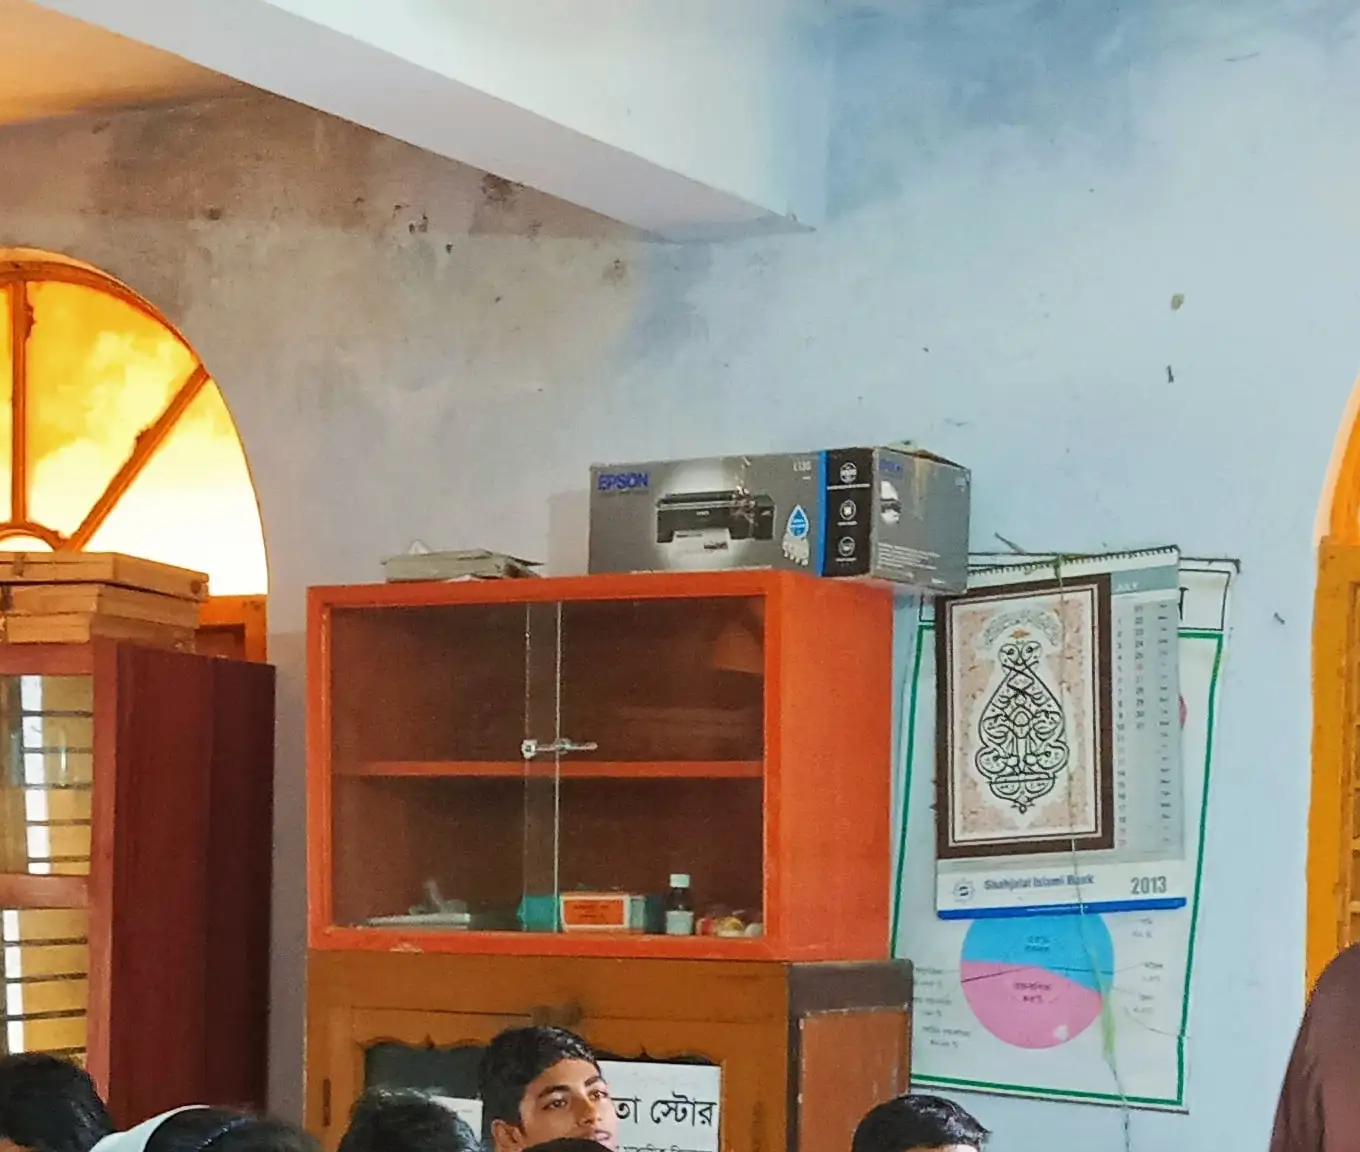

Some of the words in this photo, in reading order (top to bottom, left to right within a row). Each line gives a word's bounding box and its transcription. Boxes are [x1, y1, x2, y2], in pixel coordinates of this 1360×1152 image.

[598, 472, 649, 491] EPSON
[1067, 874, 1095, 886] Bank
[1130, 876, 1168, 895] 2013
[611, 1096, 641, 1124] তা
[650, 1091, 718, 1127] স্টোর
